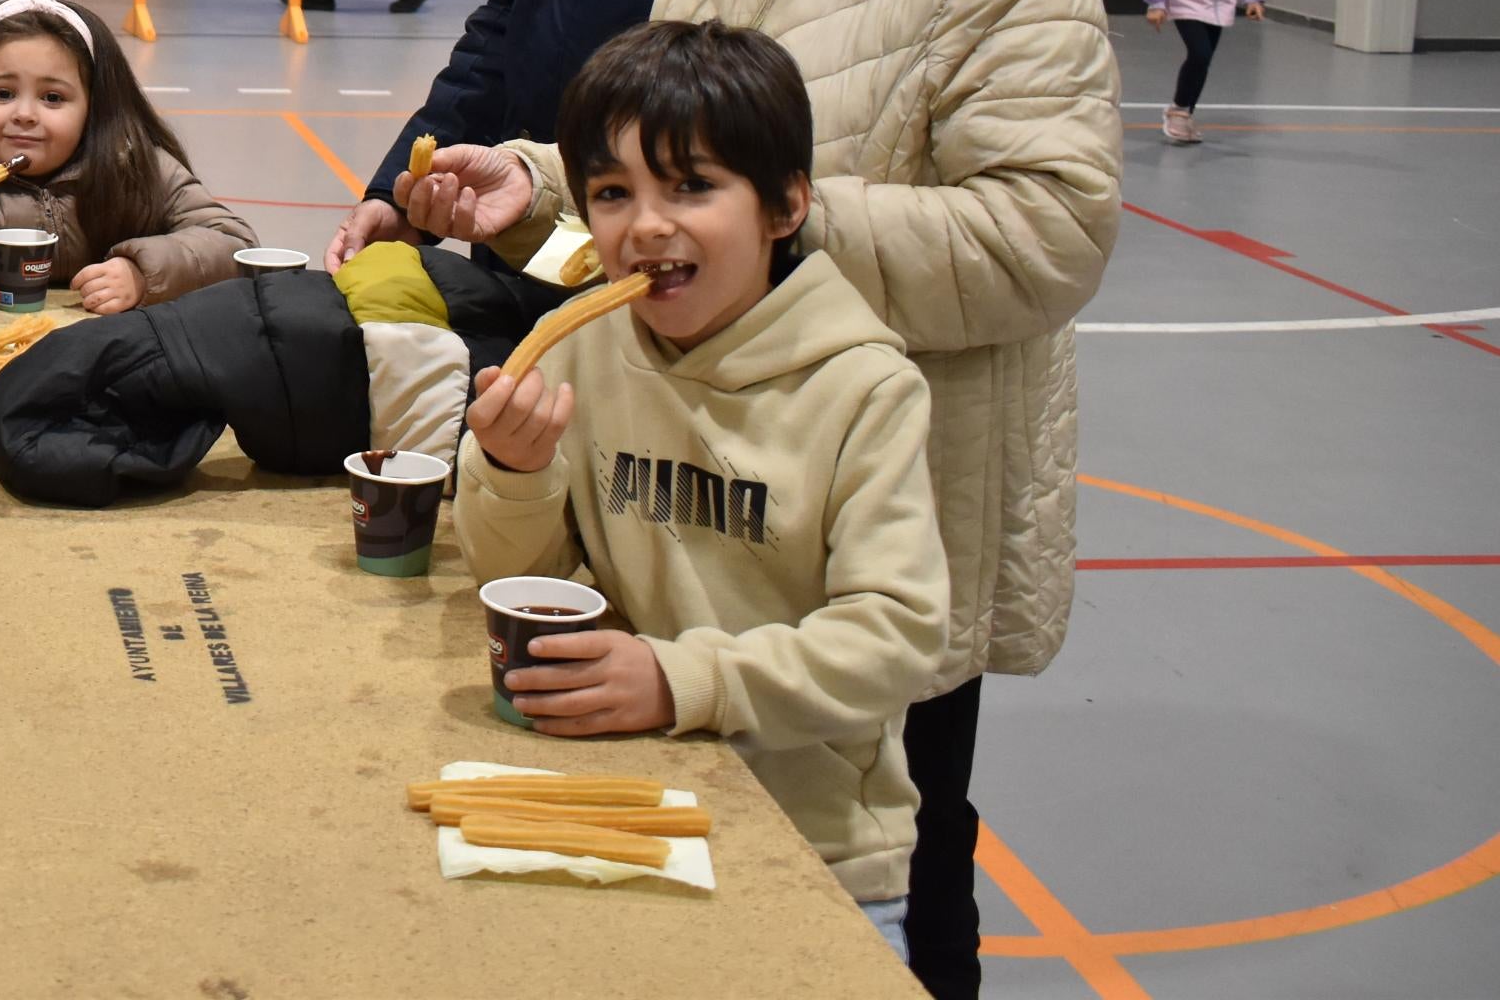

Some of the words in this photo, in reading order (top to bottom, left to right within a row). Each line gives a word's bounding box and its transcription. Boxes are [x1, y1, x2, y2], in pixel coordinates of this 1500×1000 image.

[607, 451, 768, 545] PUMA
[181, 571, 213, 604] REINA
[194, 607, 220, 622] LA
[108, 588, 157, 682] AYUNTAMIENTO
[160, 625, 186, 641] DE
[199, 624, 227, 640] DE
[206, 642, 252, 704] VILLARES
